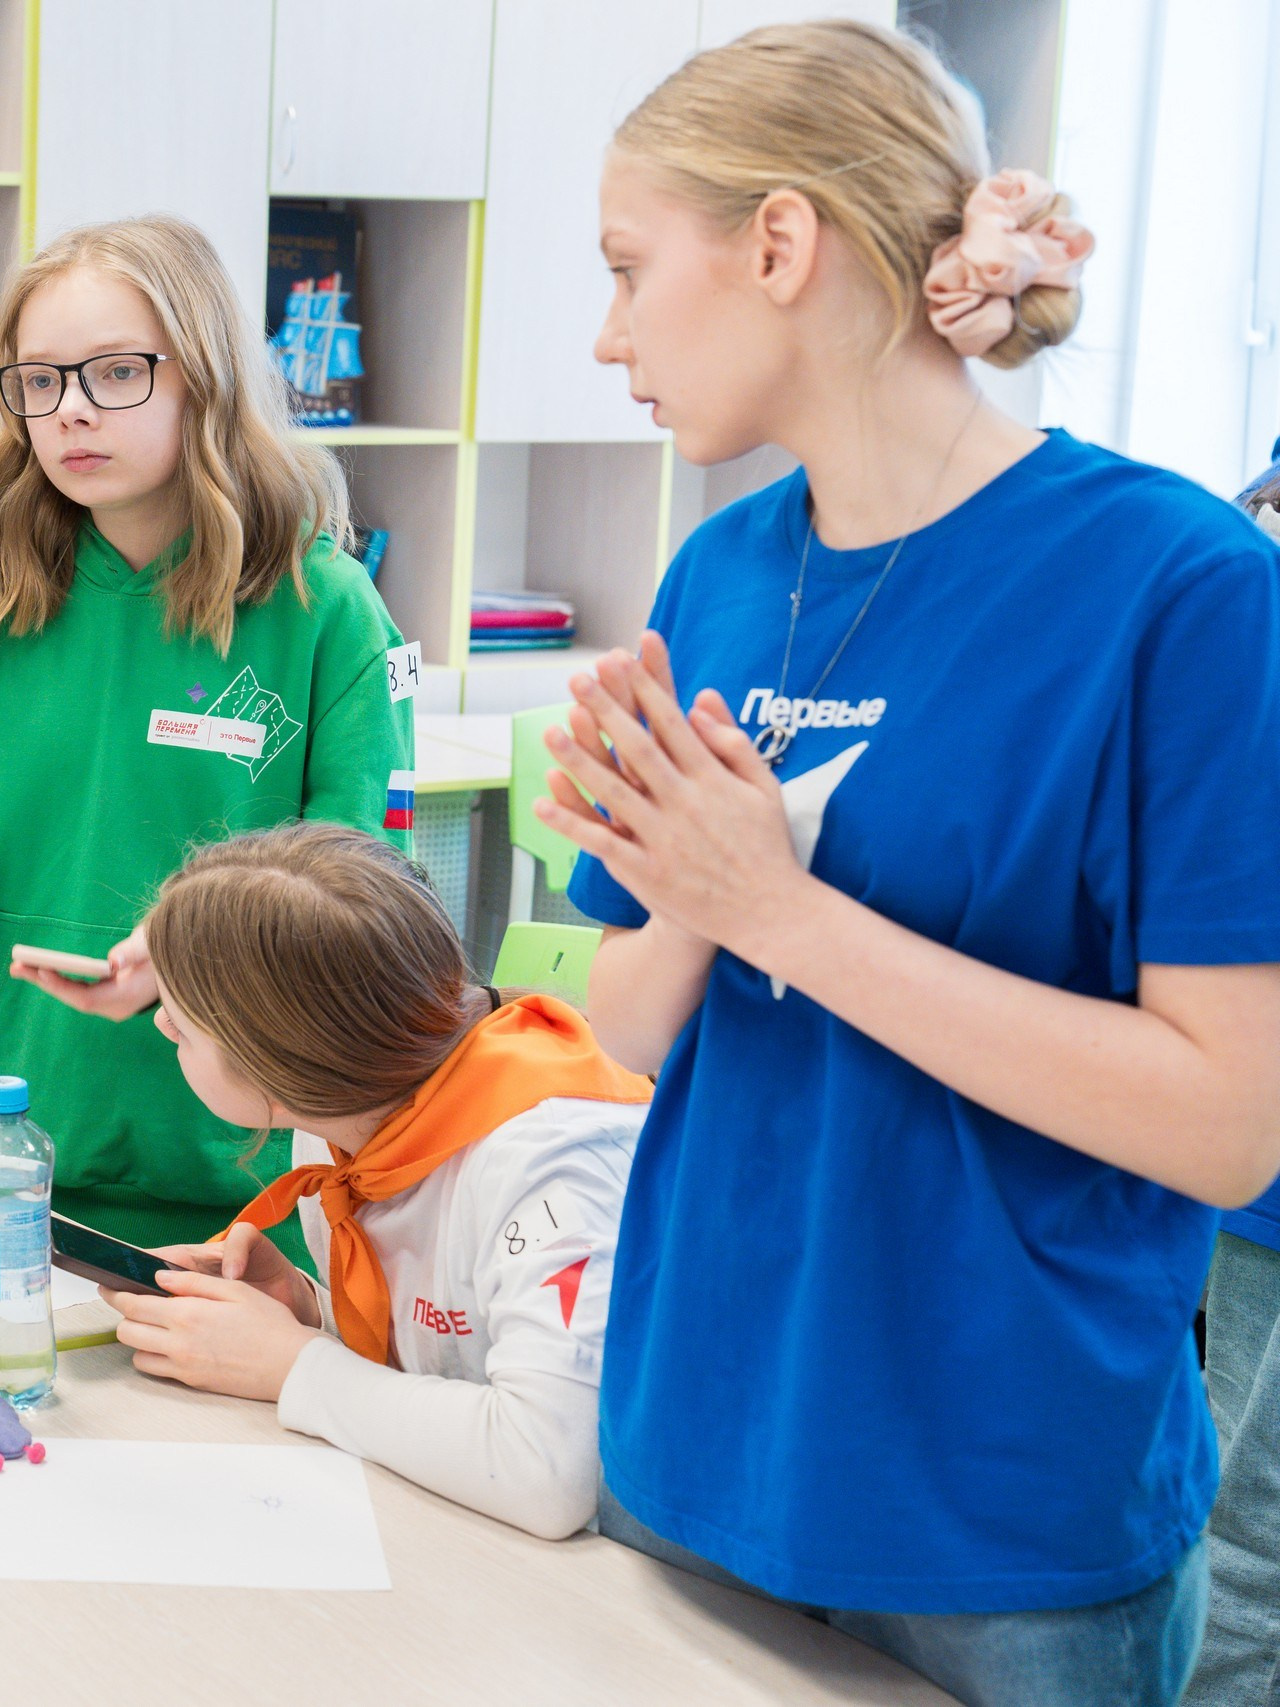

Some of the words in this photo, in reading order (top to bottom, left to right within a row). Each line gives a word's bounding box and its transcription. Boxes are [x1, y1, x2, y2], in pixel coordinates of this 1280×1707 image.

[739, 688, 887, 738] Первые
[157, 719, 199, 730] БОЛЬШАЯ
[155, 725, 197, 736] ПЕРЕМЕНА
[234, 733, 257, 744] Первые
[504, 1200, 558, 1255] 8.1
